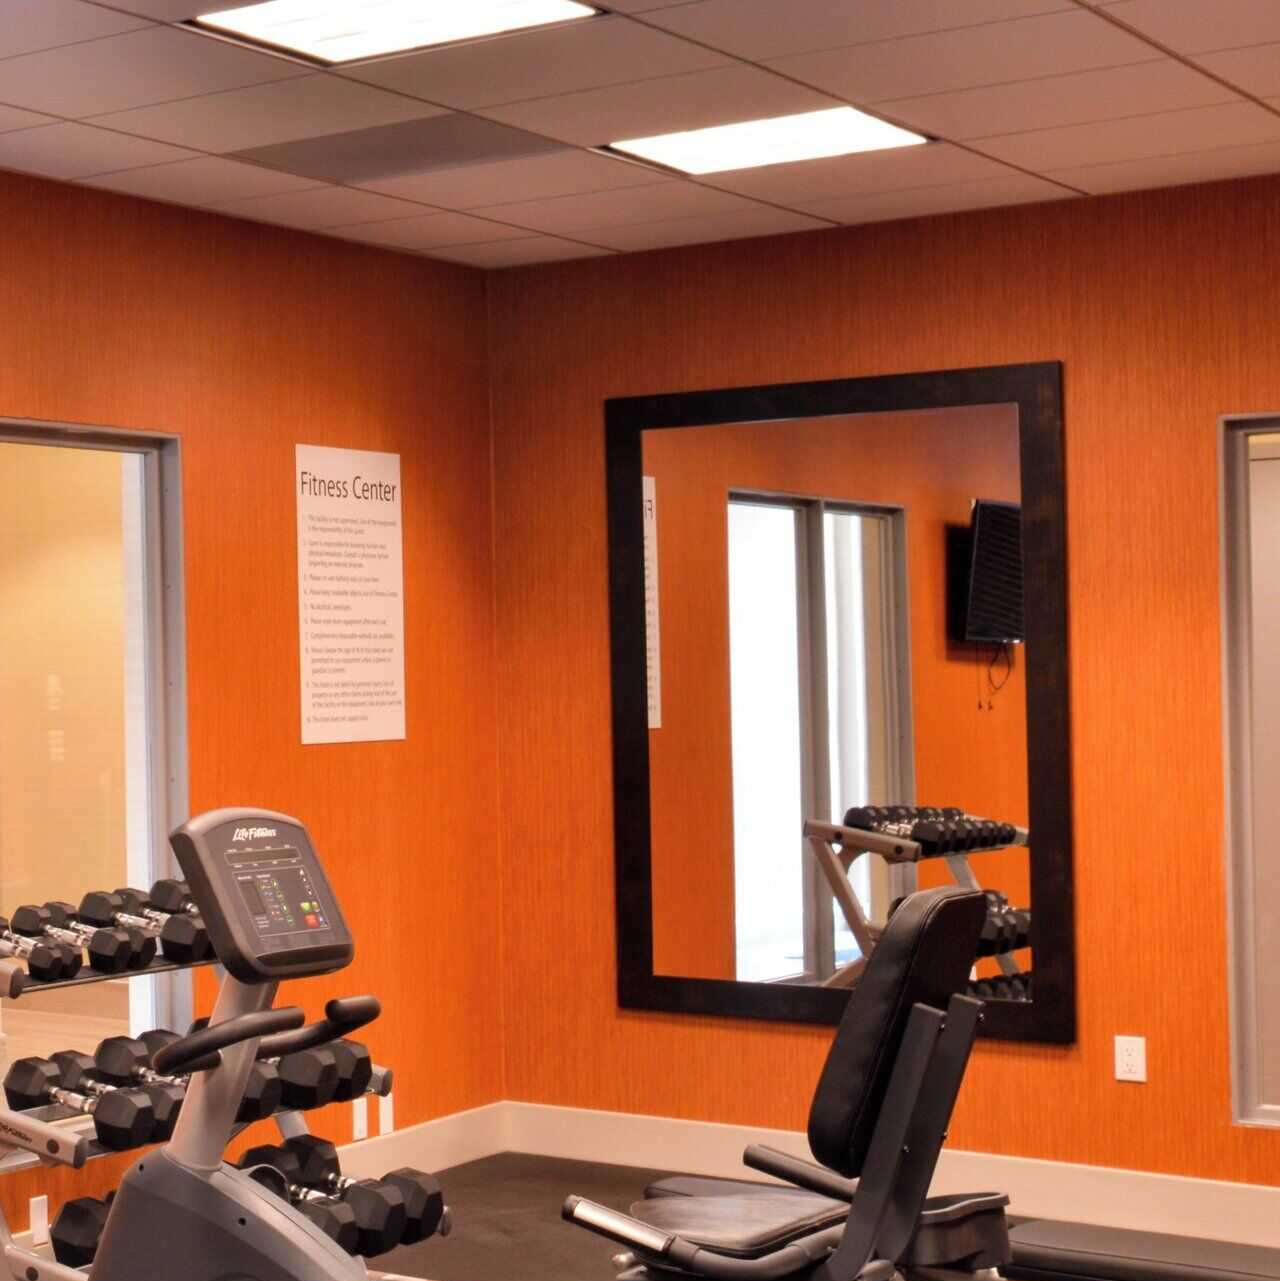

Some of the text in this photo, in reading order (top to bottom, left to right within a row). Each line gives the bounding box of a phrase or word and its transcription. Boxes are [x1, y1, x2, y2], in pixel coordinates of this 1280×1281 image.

[301, 471, 397, 501] Fitness Center
[232, 828, 248, 841] Life
